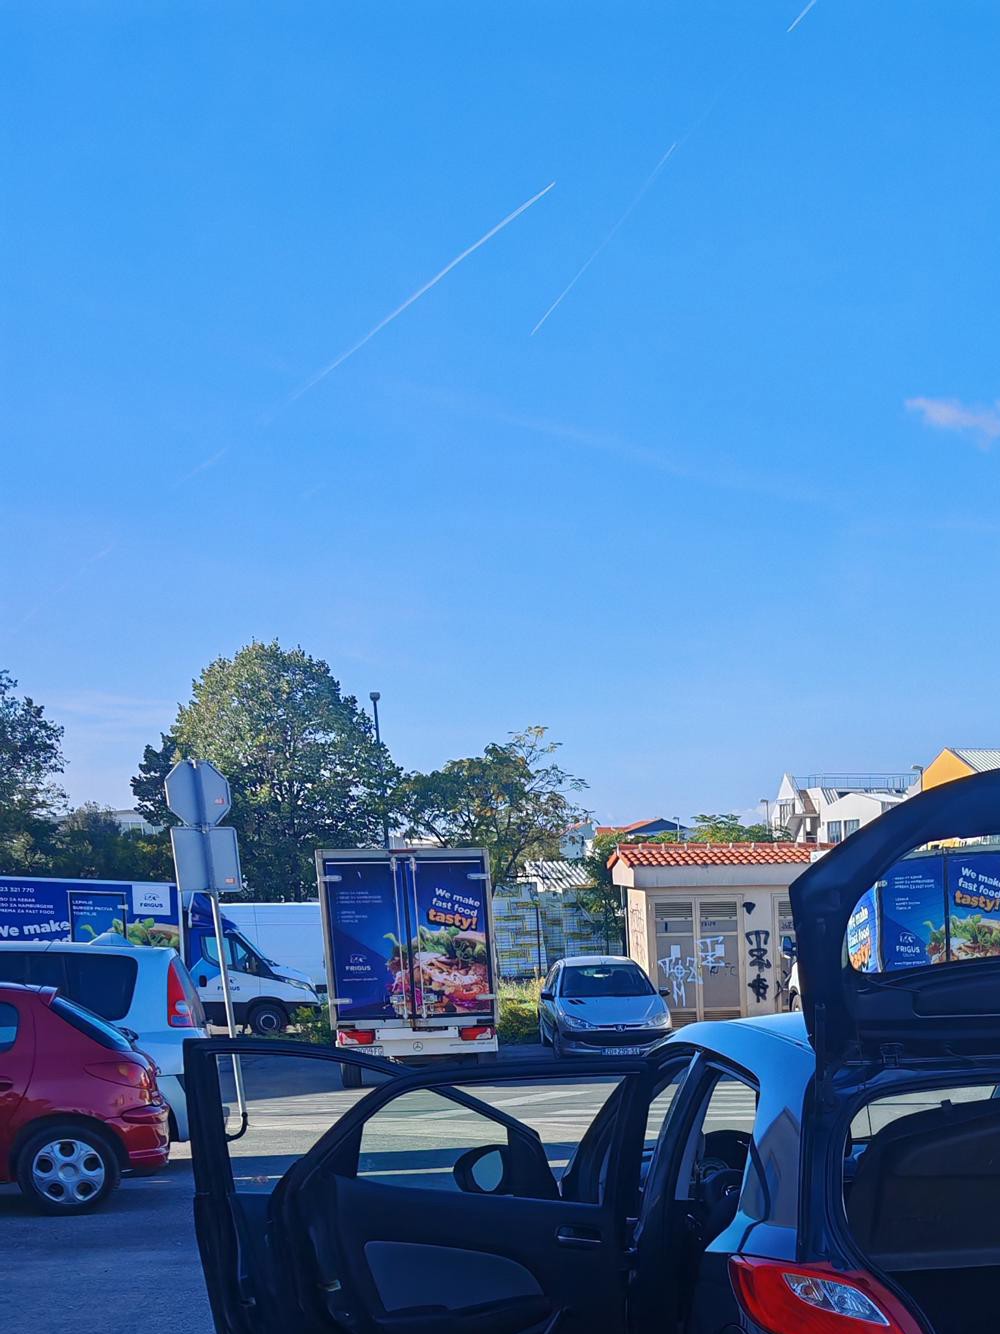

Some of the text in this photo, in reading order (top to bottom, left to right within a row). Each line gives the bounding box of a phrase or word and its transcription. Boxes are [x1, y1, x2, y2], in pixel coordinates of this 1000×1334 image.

[961, 866, 977, 879] We
[958, 877, 978, 892] fast
[435, 887, 480, 908] We make
[954, 889, 1000, 912] tasty!
[432, 897, 478, 917] fast food
[23, 919, 71, 936] make
[428, 908, 478, 930] tasty!
[895, 945, 920, 953] FRIGUS
